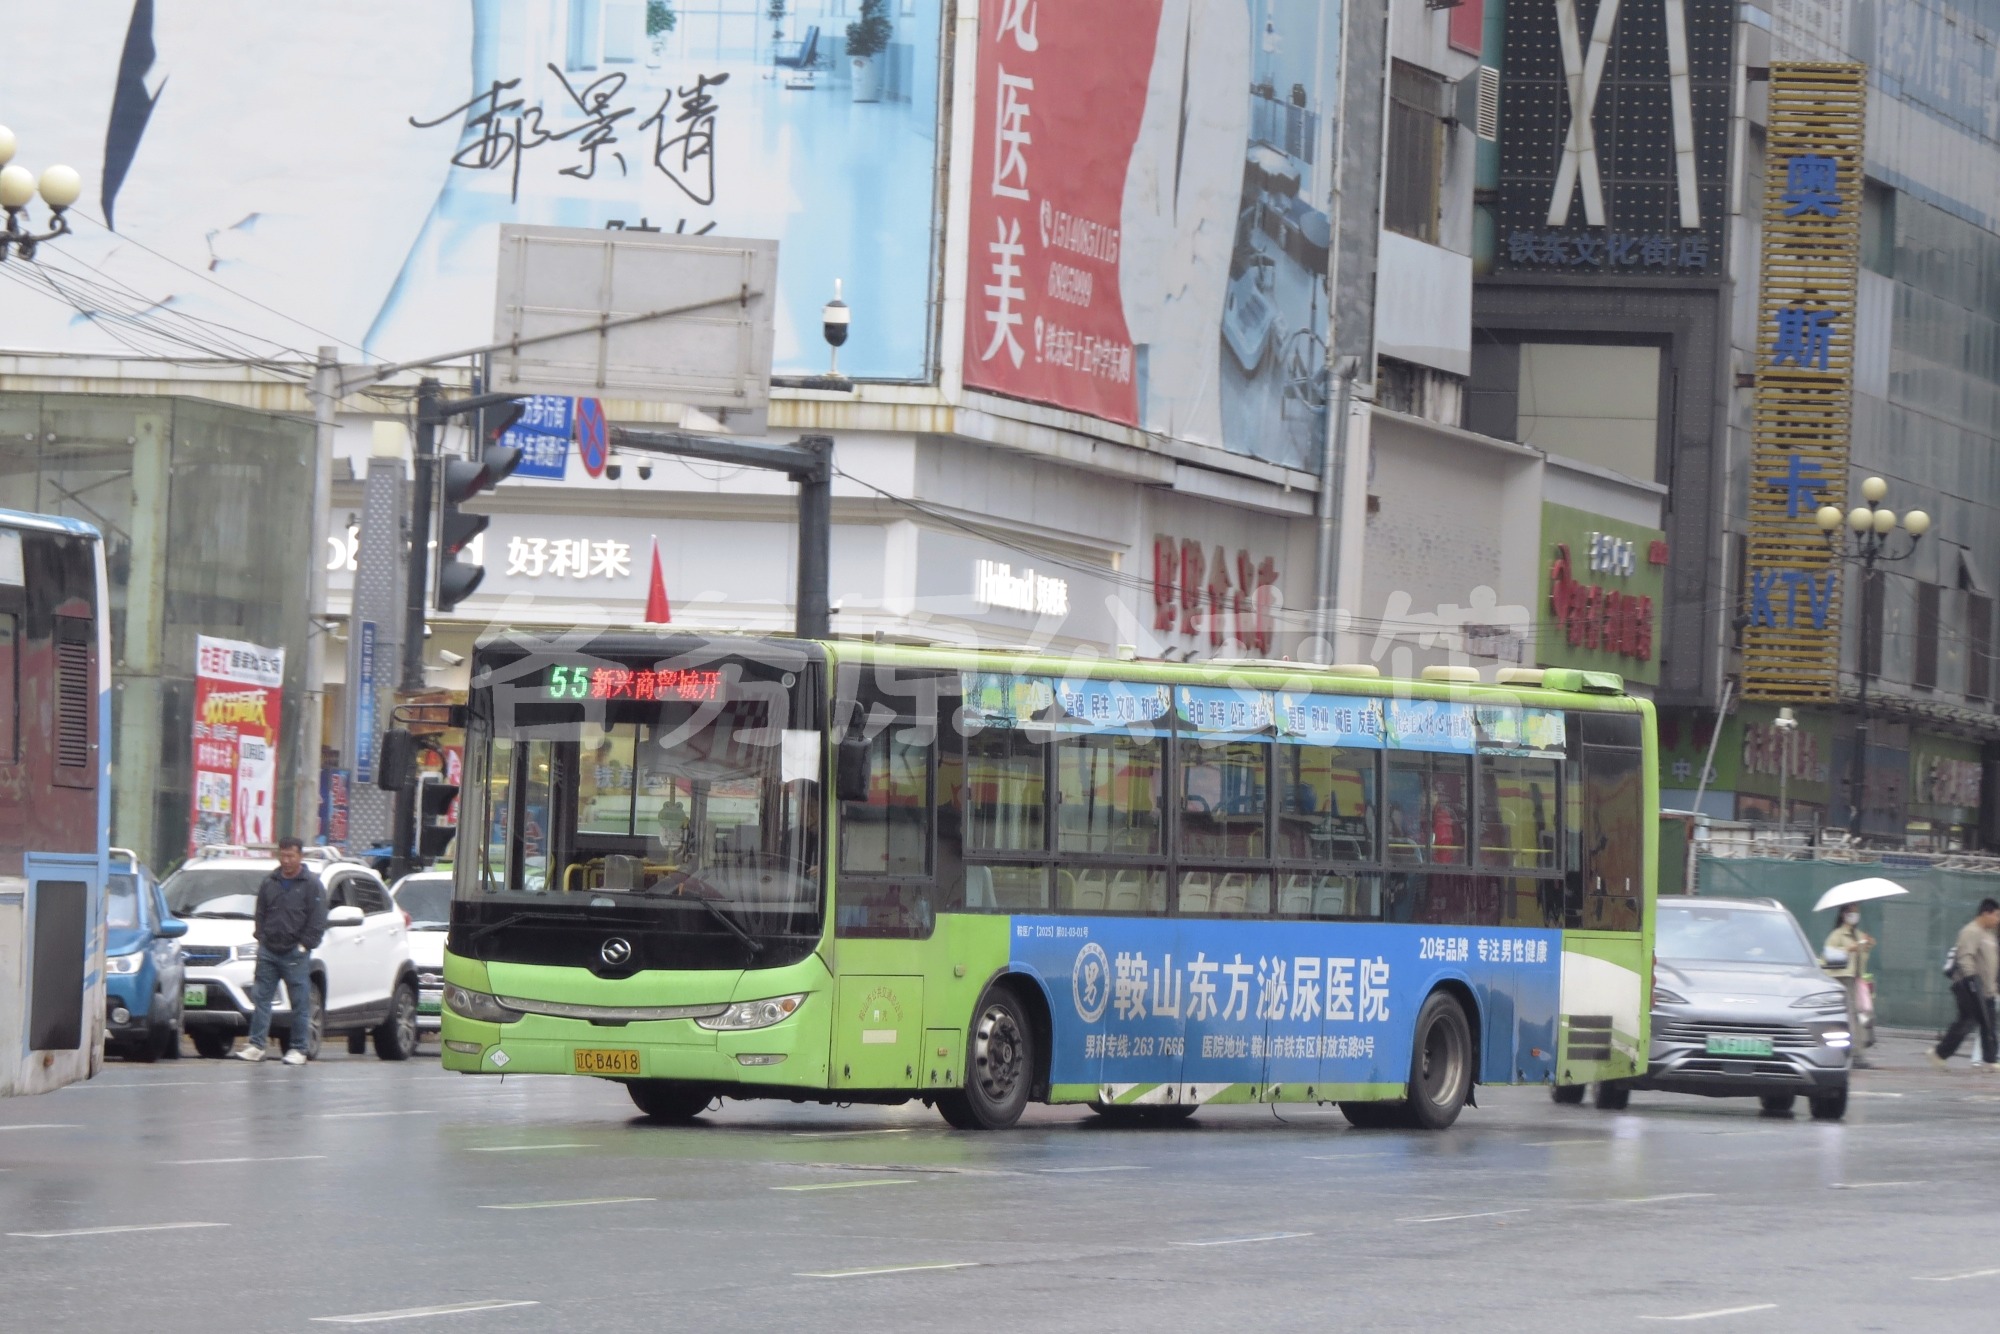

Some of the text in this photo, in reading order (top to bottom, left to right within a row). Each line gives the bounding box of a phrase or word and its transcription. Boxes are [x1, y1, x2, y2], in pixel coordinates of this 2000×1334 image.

[1507, 229, 1709, 268] 铁东文化街店
[1768, 153, 1841, 518] 奥斯卡
[506, 536, 630, 579] 好利来
[1750, 571, 1836, 629] KTV
[550, 667, 589, 699] 55
[1065, 693, 1085, 718] 富强
[1091, 694, 1109, 719] 民主
[1116, 696, 1135, 721] 文明
[1187, 699, 1205, 725] 自由
[1209, 700, 1225, 725] 平等
[1229, 701, 1246, 726] 公正
[1288, 706, 1377, 735] 爱国 敬业 诚信 友善
[1419, 937, 1548, 963] 20年品牌 专注男性健康
[1113, 951, 1390, 1022] 鞍山东方泌尿医院
[1133, 1035, 1154, 1057] 263
[1157, 1036, 1185, 1057] 7666
